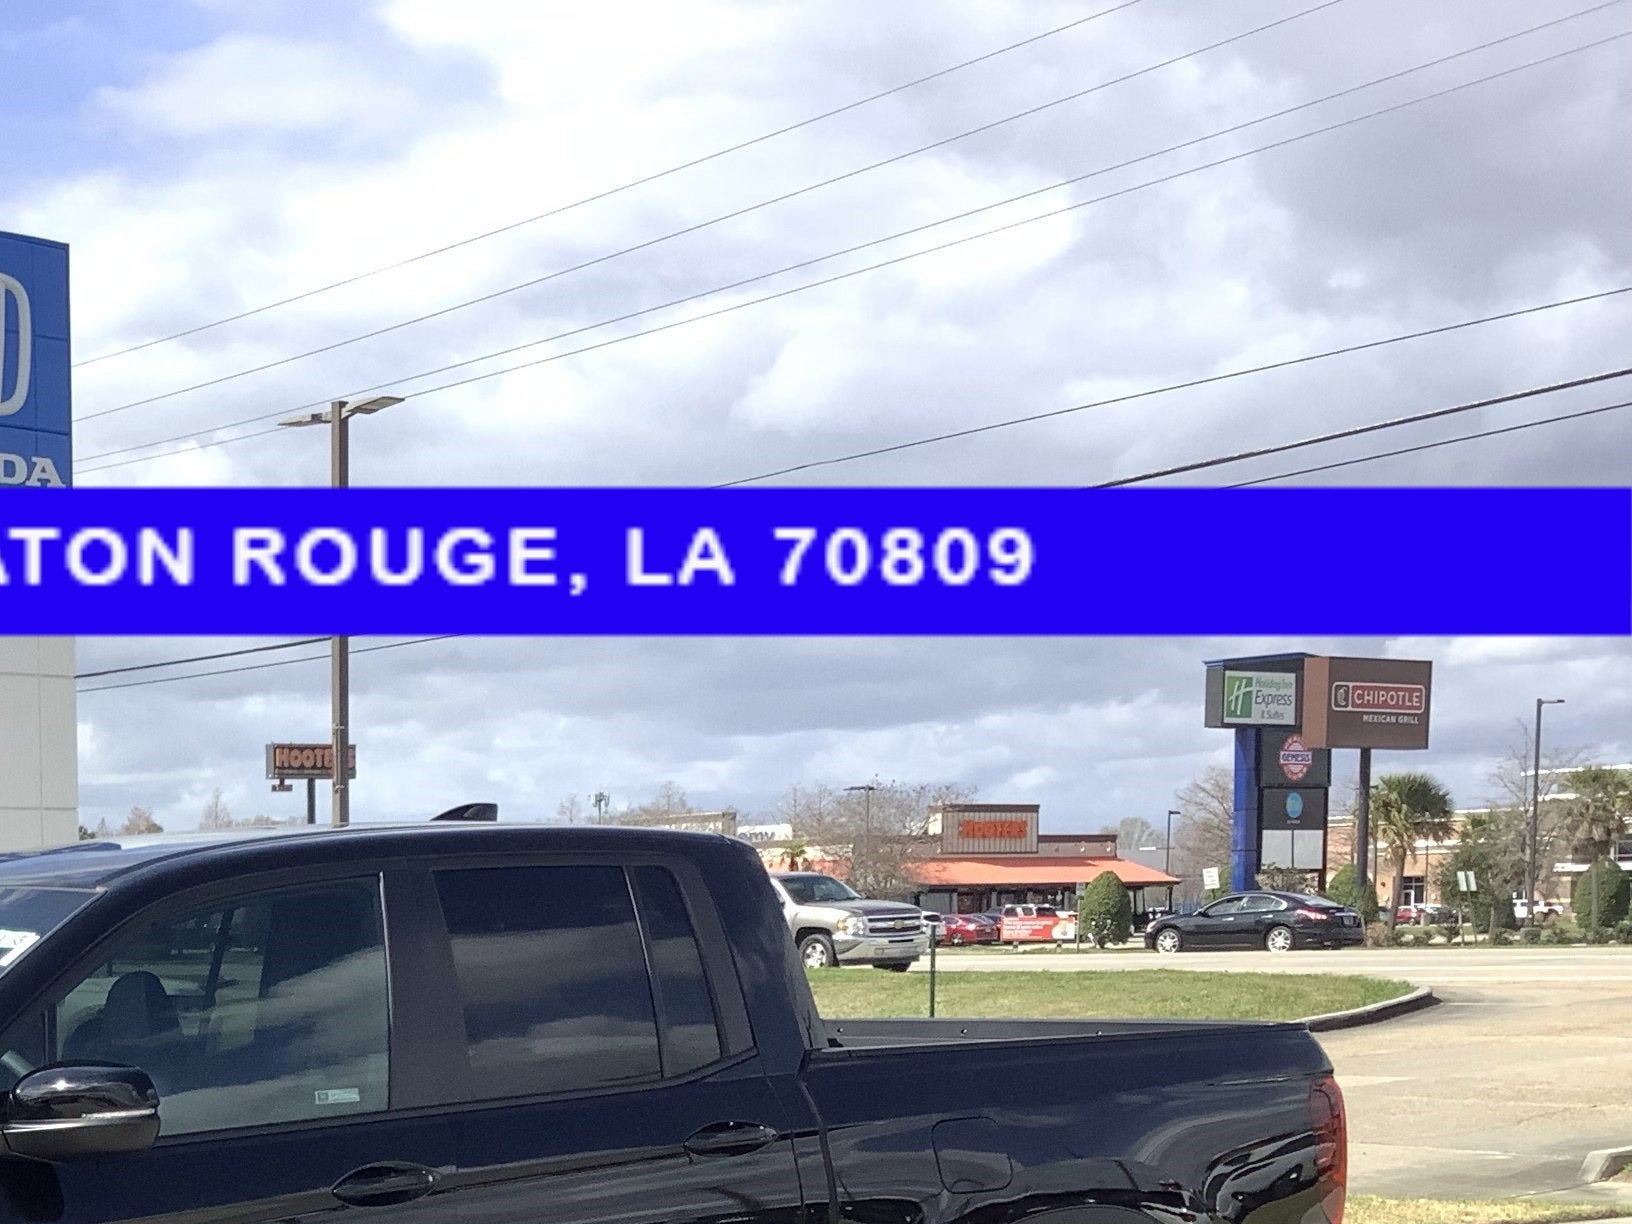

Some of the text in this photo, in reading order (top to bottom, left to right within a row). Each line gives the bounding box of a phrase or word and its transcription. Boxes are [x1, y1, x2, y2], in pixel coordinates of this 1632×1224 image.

[1255, 690, 1293, 708] Express
[1354, 690, 1421, 706] CHIPOTLE
[1363, 714, 1420, 724] MEXICAN GRILL
[275, 748, 355, 768] HOOTES
